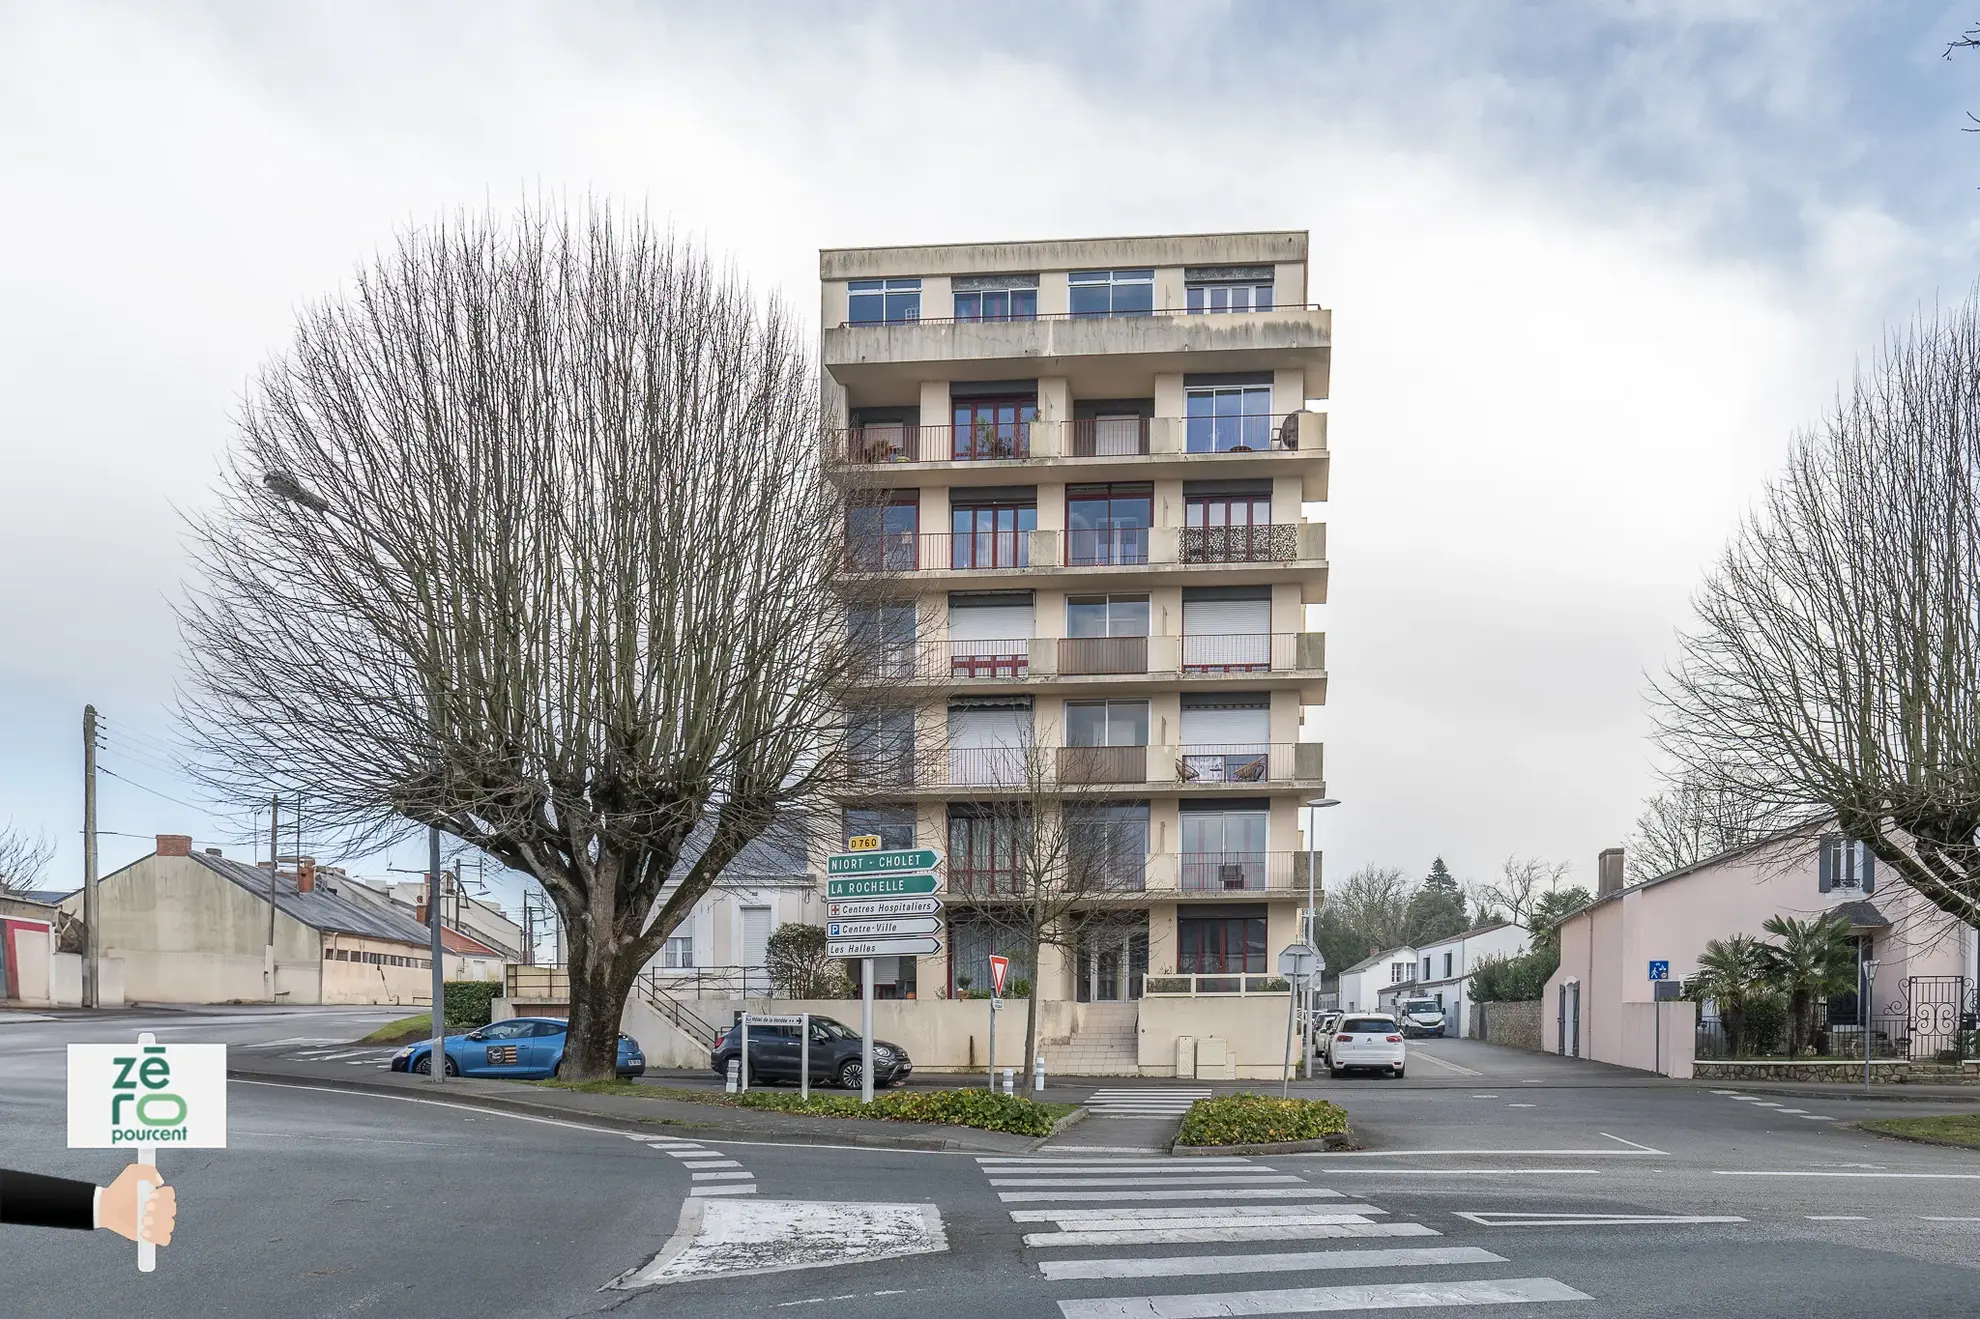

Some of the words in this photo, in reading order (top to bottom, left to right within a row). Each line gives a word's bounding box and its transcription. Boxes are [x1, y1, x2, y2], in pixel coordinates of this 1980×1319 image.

[851, 840, 857, 848] D
[859, 838, 877, 848] 760
[831, 858, 863, 870] NIORT
[879, 854, 921, 867] CHOLET
[831, 883, 843, 894] LA
[849, 880, 904, 893] ROCHELLE
[842, 905, 875, 914] Centres
[878, 903, 931, 913] Hospitaliers
[842, 923, 897, 933] Centre-Ville
[830, 945, 844, 954] Les
[848, 944, 876, 953] Halles
